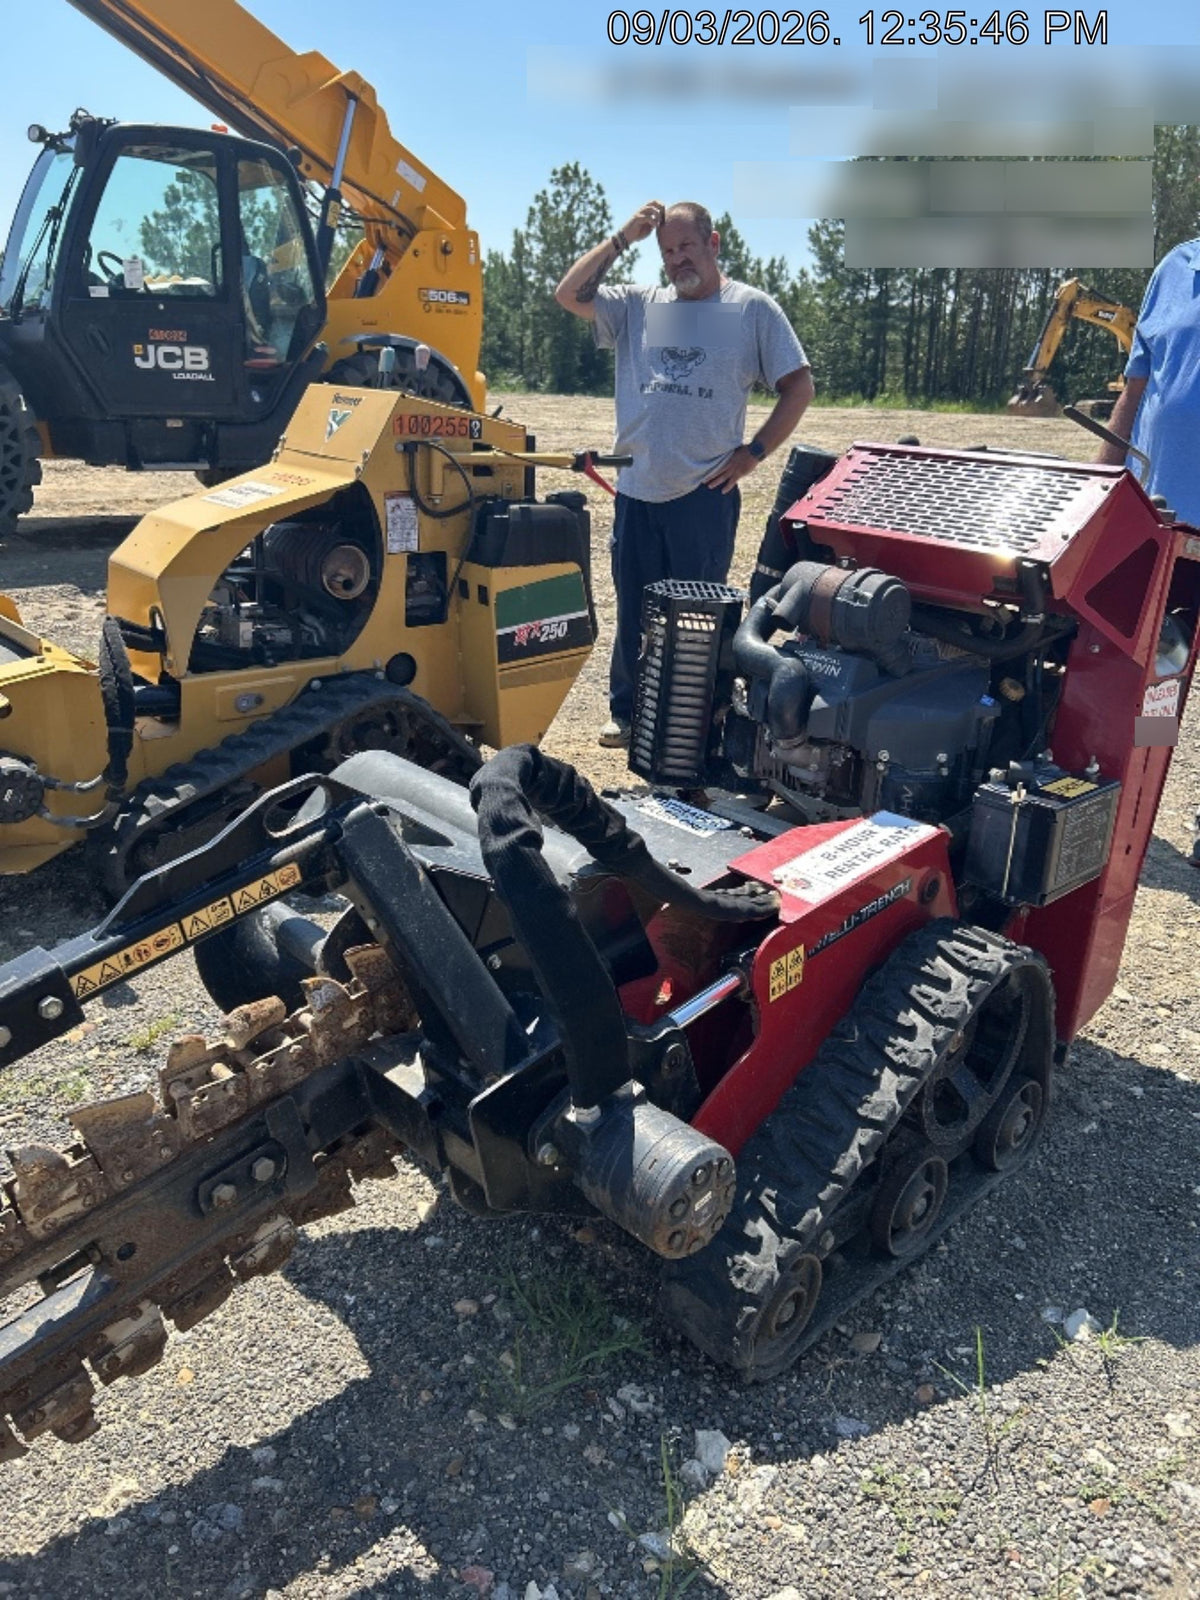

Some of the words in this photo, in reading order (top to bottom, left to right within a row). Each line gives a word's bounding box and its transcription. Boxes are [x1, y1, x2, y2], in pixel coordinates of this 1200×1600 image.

[134, 344, 209, 371] JCB
[394, 415, 468, 436] 100255
[824, 847, 884, 880] RENTAL
